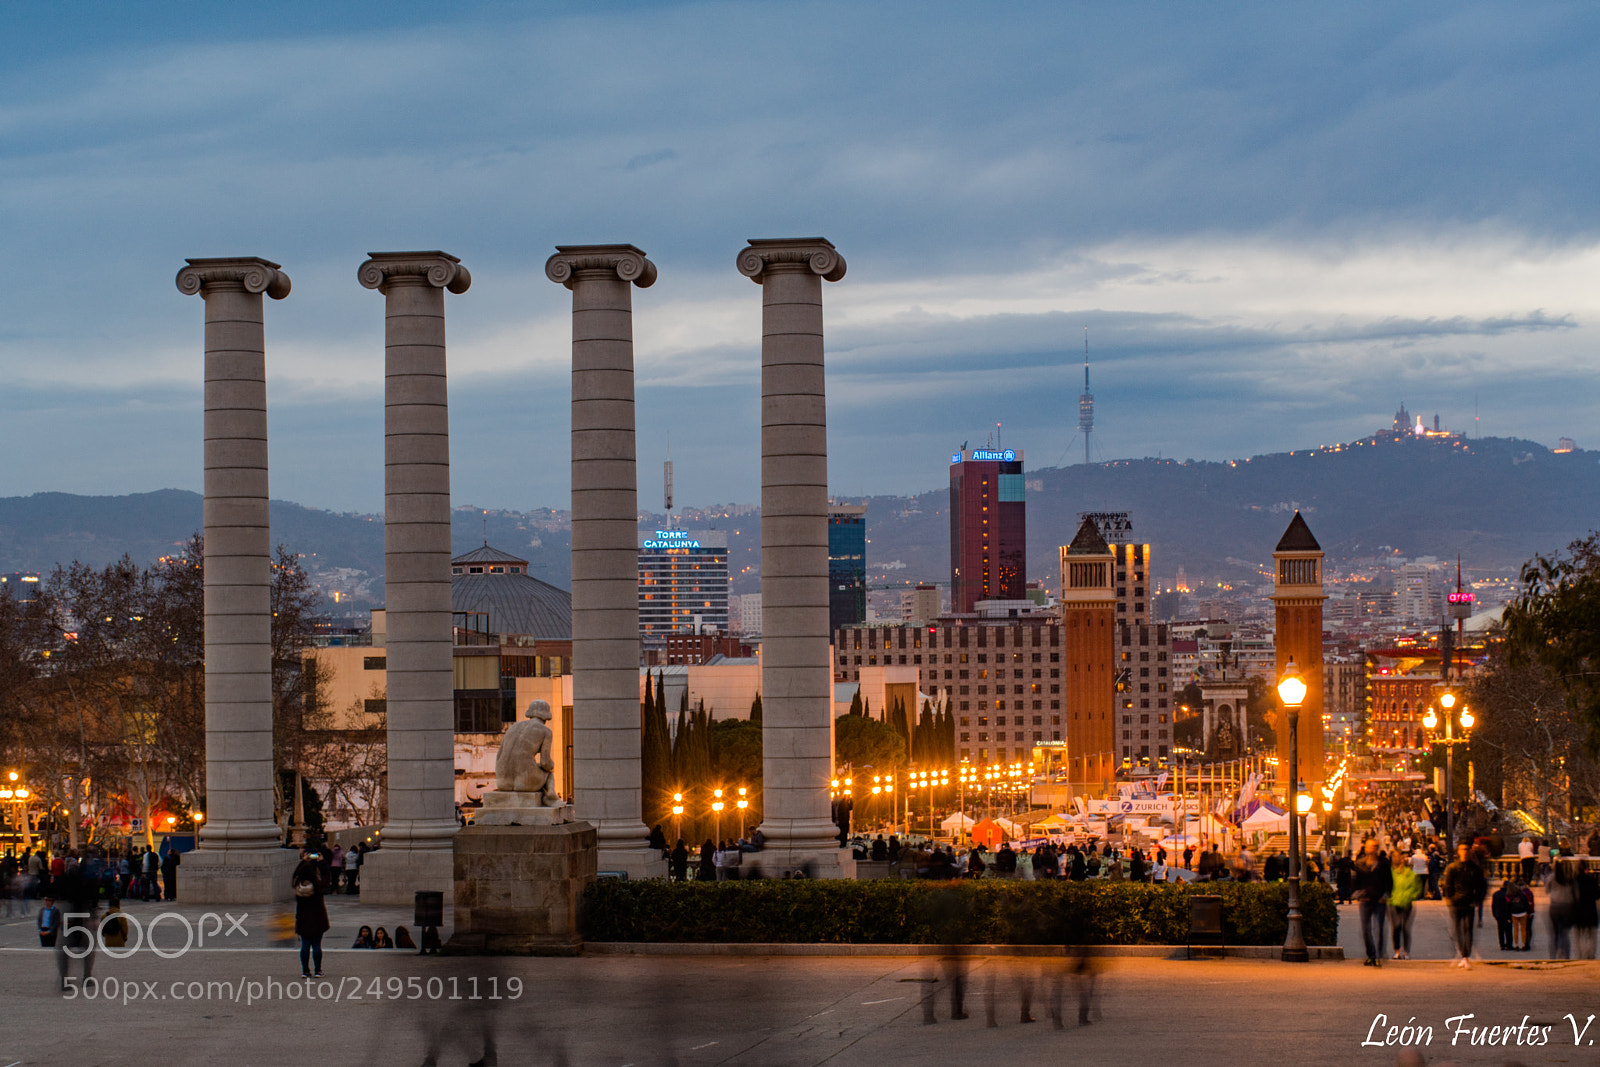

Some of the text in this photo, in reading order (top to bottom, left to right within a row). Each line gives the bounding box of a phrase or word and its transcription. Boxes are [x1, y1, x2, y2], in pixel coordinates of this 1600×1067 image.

[972, 450, 1003, 460] Allianz
[1096, 521, 1133, 530] LAZA
[655, 530, 688, 539] TORRE
[643, 540, 700, 548] CATALUNYA
[1135, 803, 1168, 811] ZURICH
